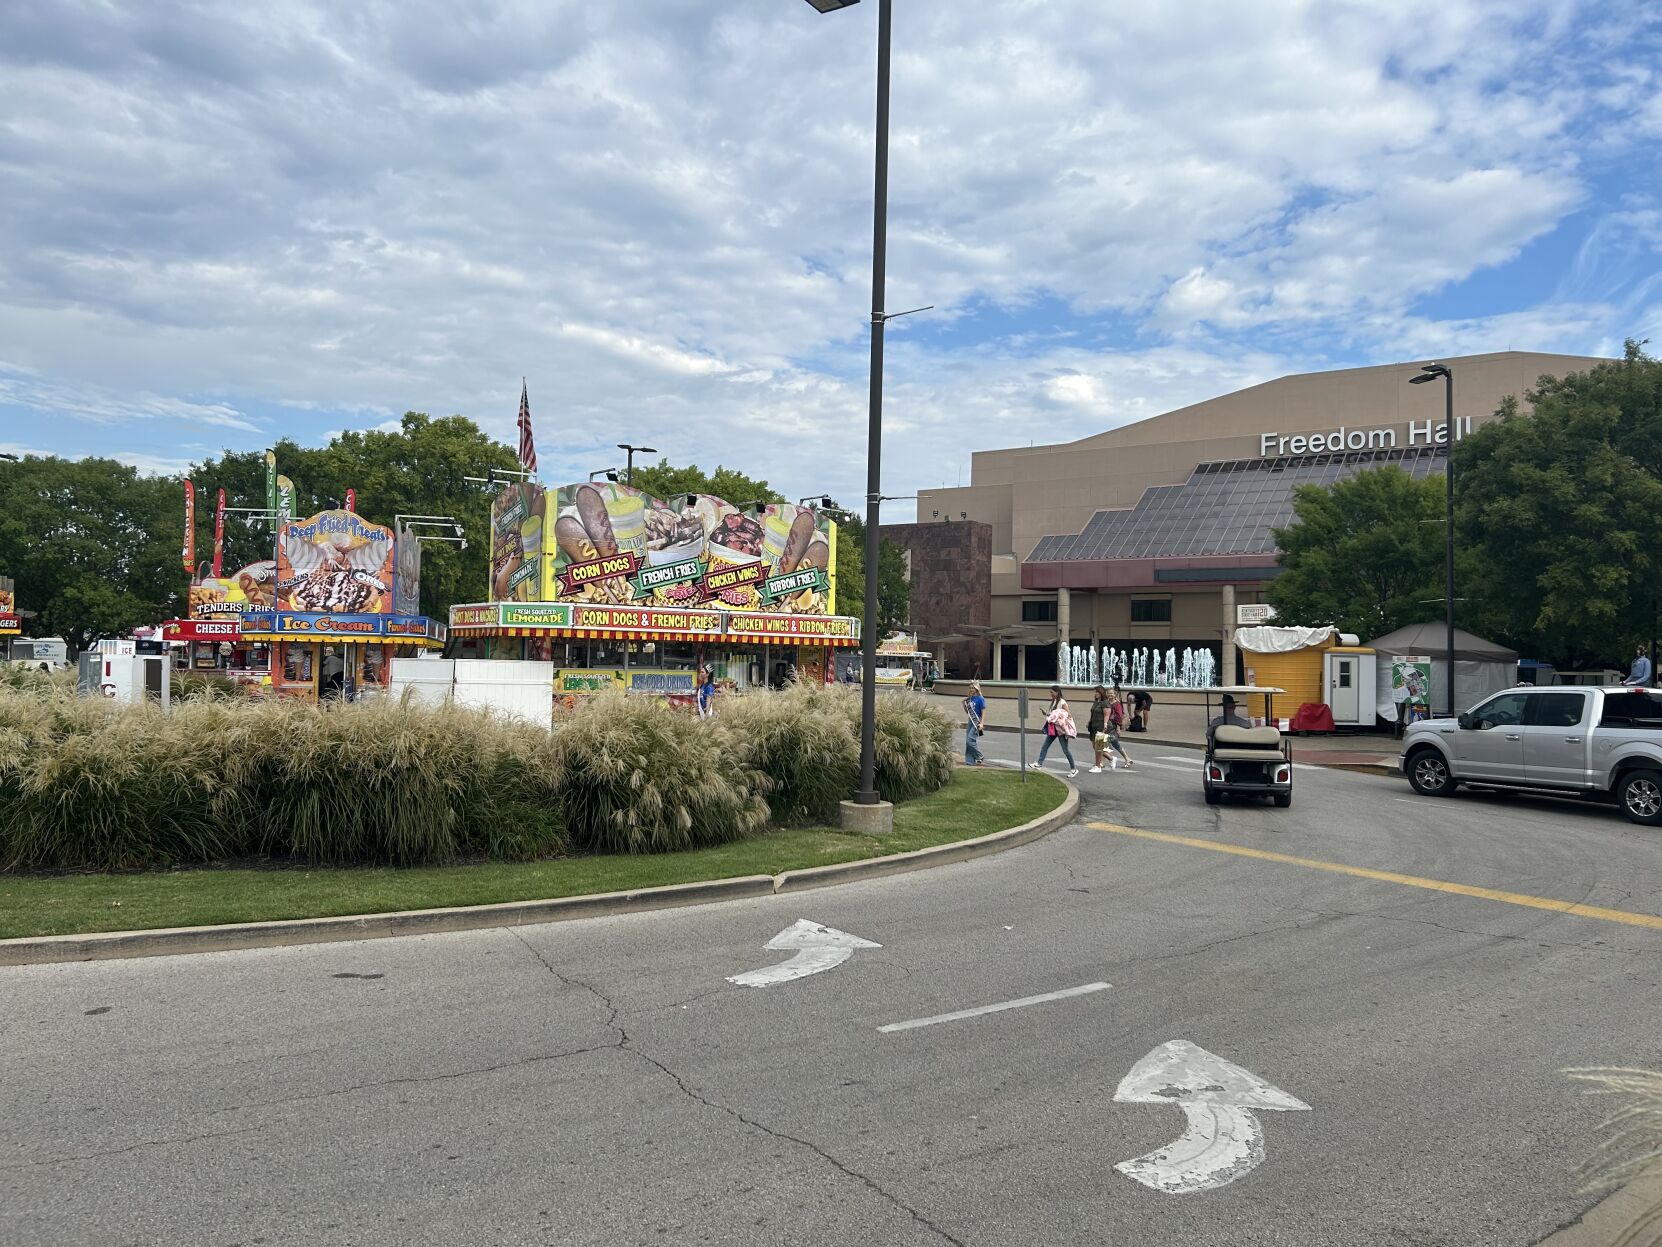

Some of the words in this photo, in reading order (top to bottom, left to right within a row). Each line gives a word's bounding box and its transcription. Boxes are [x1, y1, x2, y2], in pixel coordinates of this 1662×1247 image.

[1259, 426, 1396, 457] Freedom
[1409, 415, 1471, 445] Hall
[289, 522, 318, 543] Deep
[318, 513, 351, 536] Fried
[349, 516, 387, 541] Treats
[572, 563, 600, 581] CORN
[601, 557, 631, 573] DOGS
[642, 567, 675, 586] FRENCH
[674, 561, 697, 578] FRIES
[708, 571, 738, 589] CHICKEN
[737, 565, 759, 582] WINGS
[769, 576, 797, 593] RIBBON
[796, 572, 816, 588] FRIES
[197, 602, 244, 614] TENDERS
[531, 608, 559, 616] SQUEEZED
[283, 616, 312, 631] Ice
[315, 617, 375, 632] Cream
[506, 611, 564, 624] LEMONADE
[582, 610, 610, 625] CORN
[612, 611, 639, 626] DOGS
[641, 612, 650, 627] &
[651, 613, 687, 629] FRENCH
[689, 614, 715, 630] FRIES
[732, 617, 764, 631] CHICKEN
[766, 618, 789, 632] WINGS
[791, 619, 797, 633] &
[799, 620, 825, 633] RIBBON
[825, 620, 847, 635] FRIES
[195, 624, 233, 634] CHEESE
[121, 647, 133, 655] ICE
[667, 674, 693, 690] DRINKS
